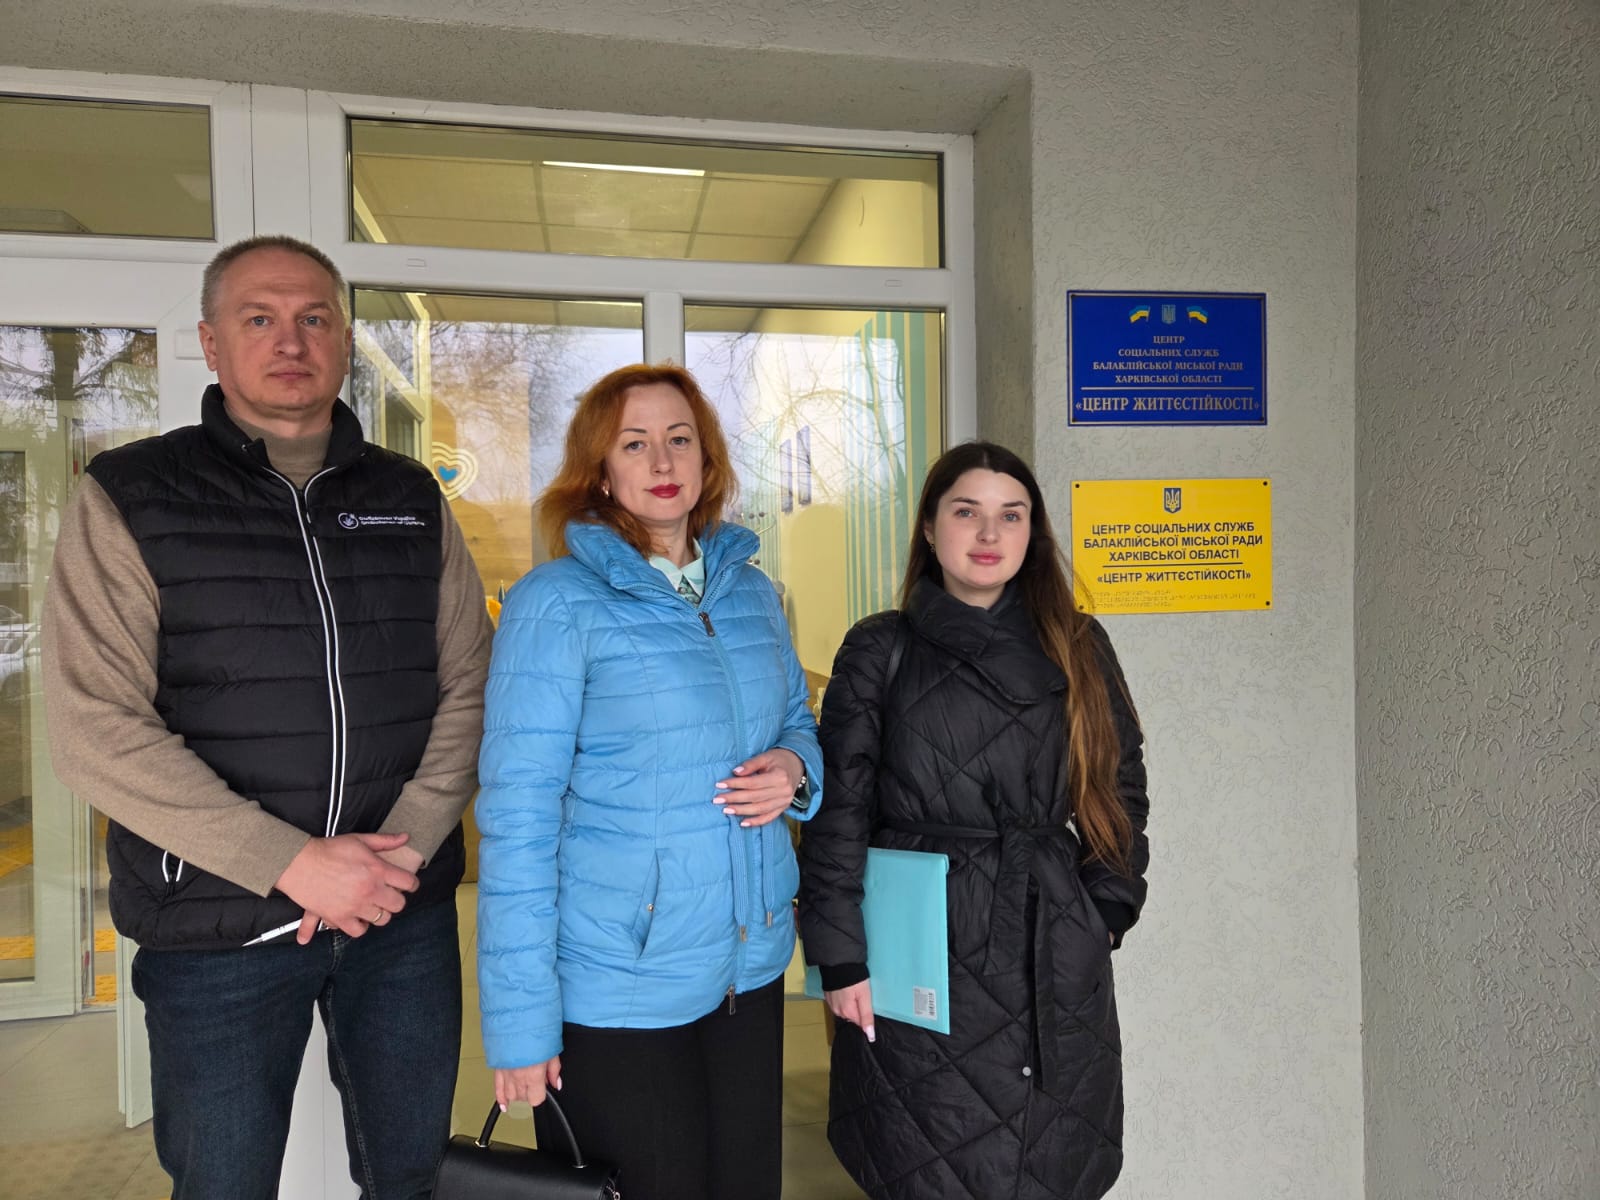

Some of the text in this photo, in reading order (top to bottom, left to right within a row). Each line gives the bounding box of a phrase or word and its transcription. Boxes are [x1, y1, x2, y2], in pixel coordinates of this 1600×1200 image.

[1153, 335, 1185, 344] ЦЕНТР
[1118, 349, 1219, 358] СОЦІАЛЬНИХ СЛУЖБ
[1092, 361, 1243, 371] БАЛАКЛІЙСЬКОЇ МІСЬКОЇ РАДИ
[1115, 374, 1222, 383] ХАРКІВСЬКОЇ ОБЛАСТІ
[1075, 394, 1259, 412] «ЦЕНТР ЖИТТЄСТІЙКОСТІ»
[1092, 521, 1255, 536] ЦЕНТР СОЦІАЛЬНИХ СЛУЖБ
[1083, 534, 1263, 549] БАЛАКЛІЙСЬКОЇ МІСЬКОЇ РАДИ
[1109, 548, 1240, 562] ХАРКІВСЬКОЇ ОБЛАСТІ
[1097, 568, 1251, 585] «ЦЕНТР ЖИТТЄСТІЙКОСТІ»
